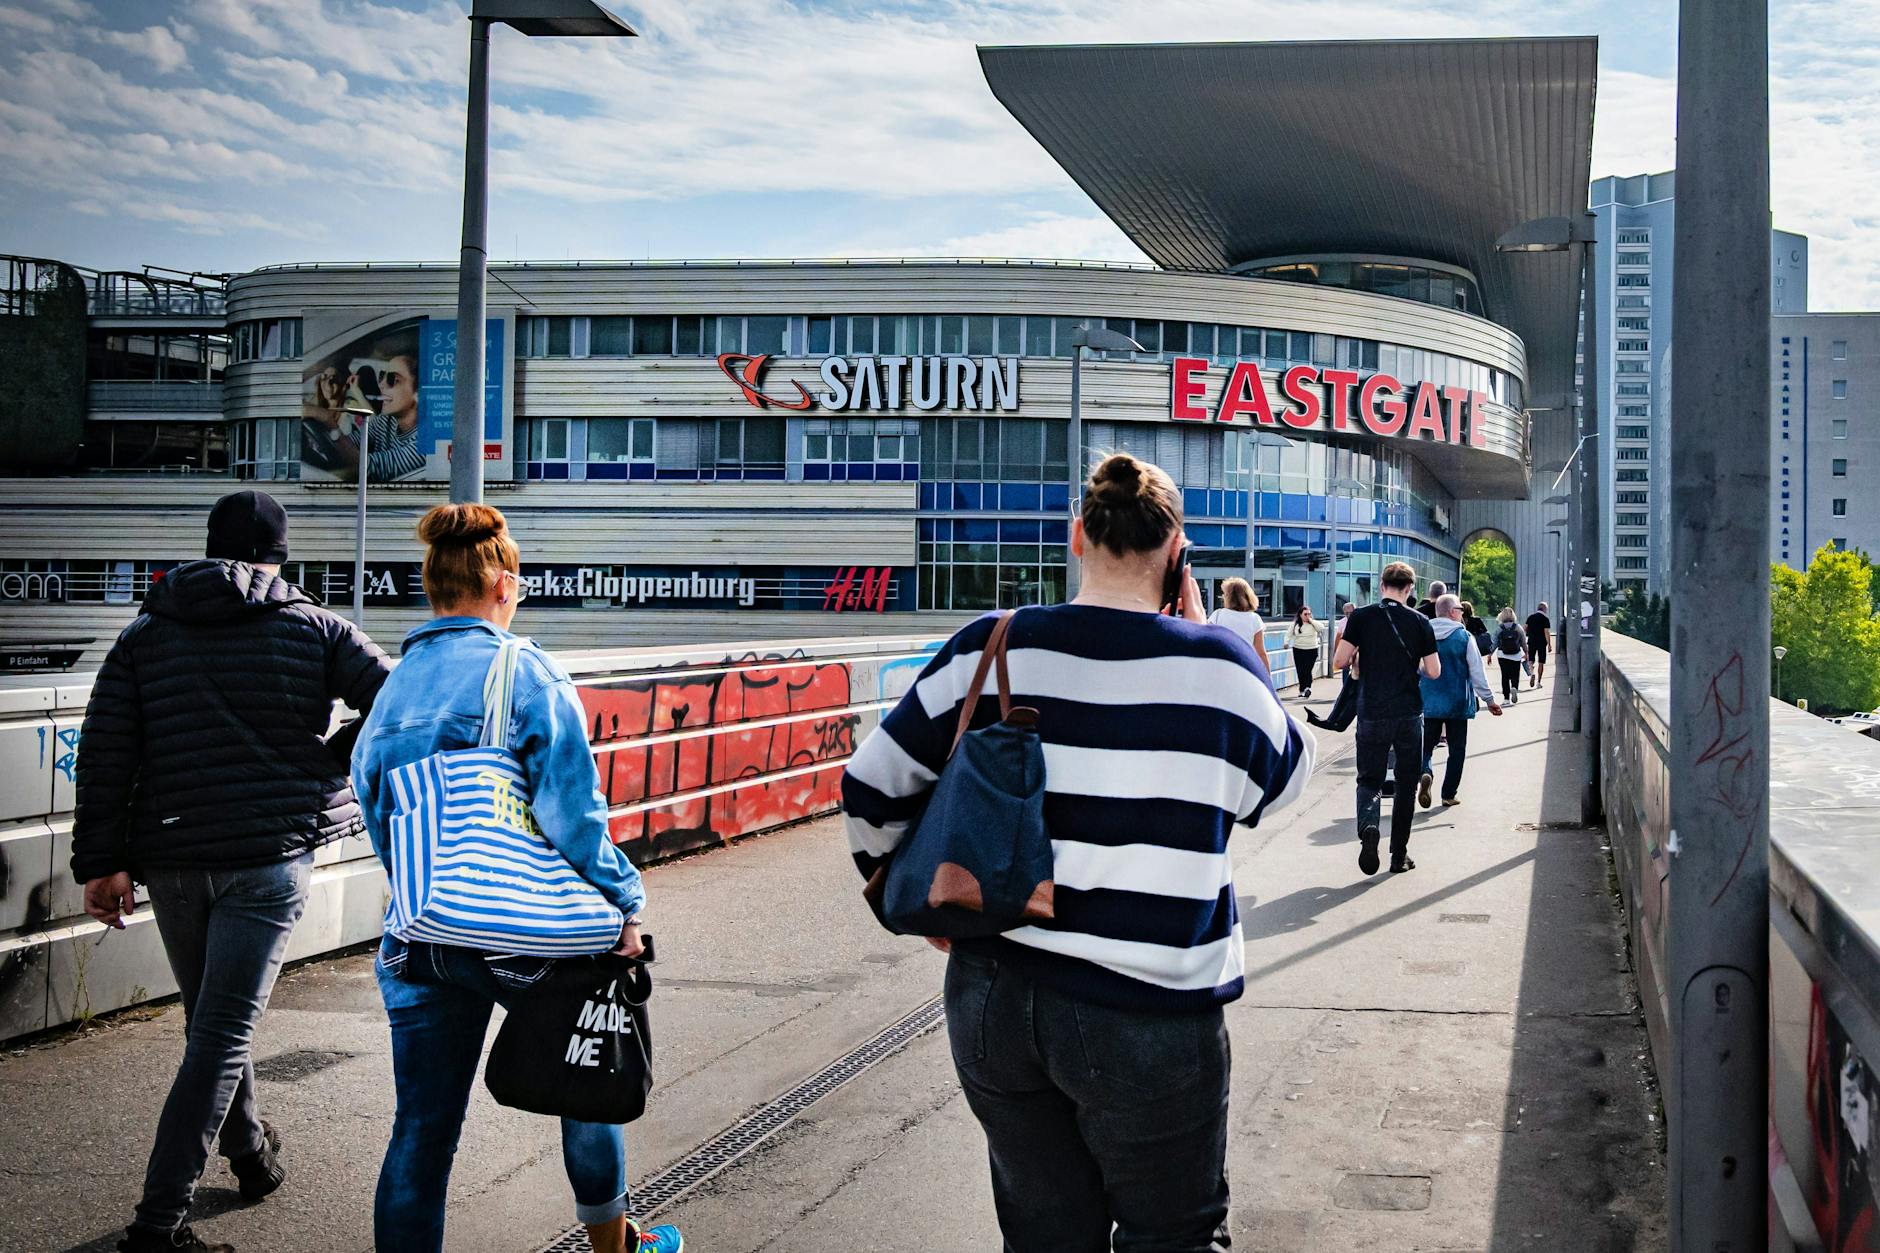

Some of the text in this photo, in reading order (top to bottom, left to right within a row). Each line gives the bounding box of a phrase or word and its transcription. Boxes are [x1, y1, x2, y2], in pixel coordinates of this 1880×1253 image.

[819, 355, 1020, 411] SATURN
[1171, 356, 1489, 449] EASTGATE
[824, 566, 892, 614] H&M
[10, 656, 49, 665] P Einfahrt
[564, 1033, 604, 1067] ME
